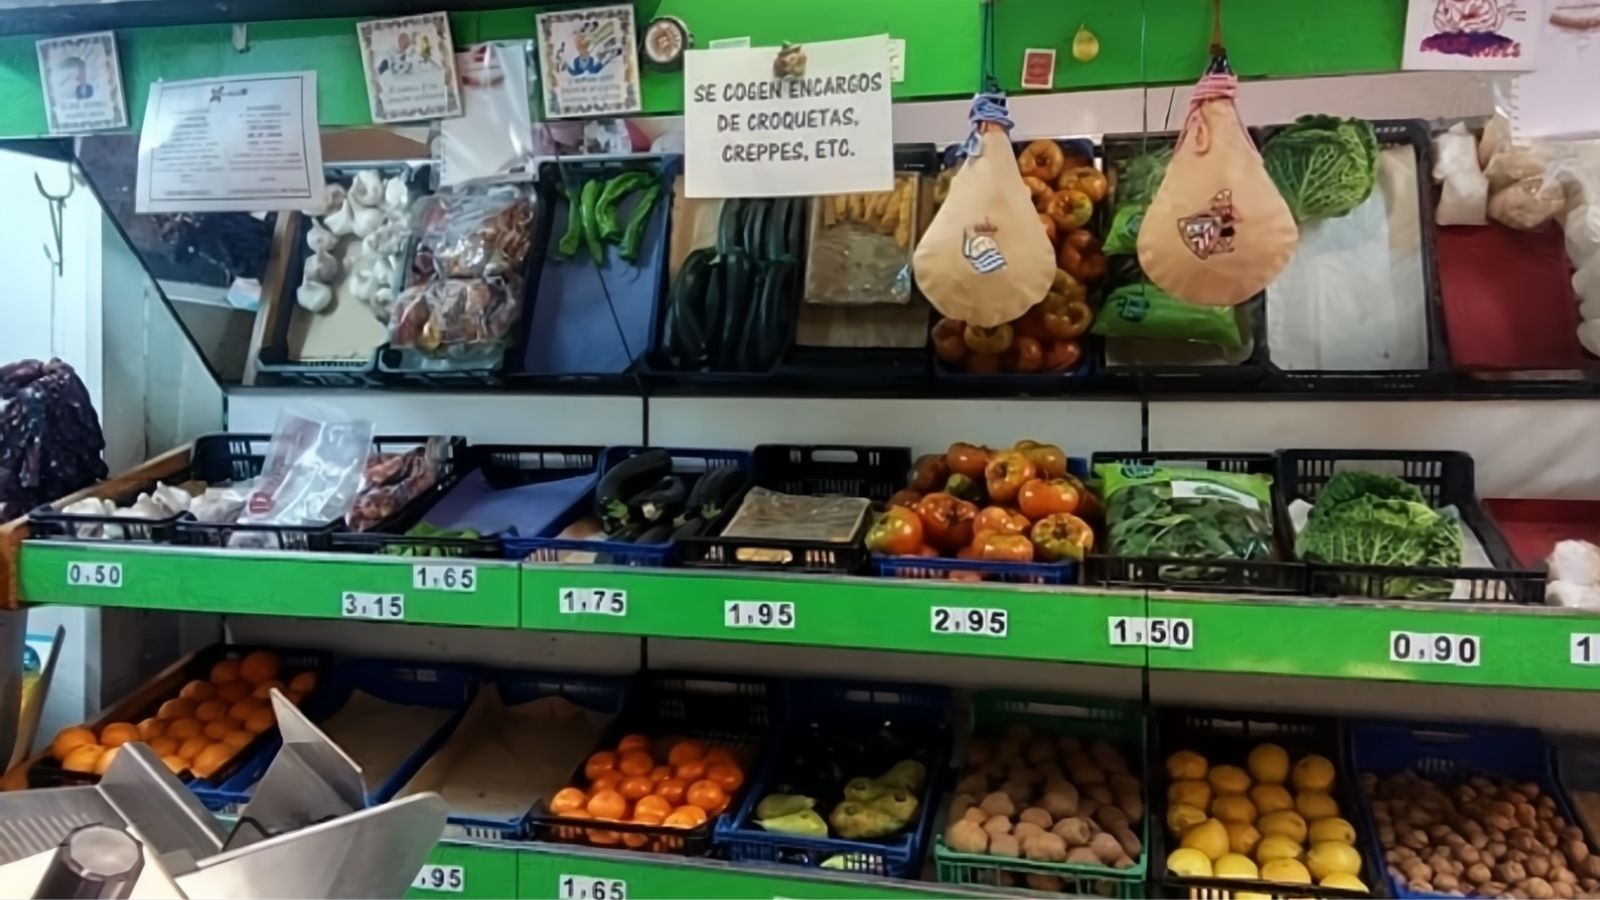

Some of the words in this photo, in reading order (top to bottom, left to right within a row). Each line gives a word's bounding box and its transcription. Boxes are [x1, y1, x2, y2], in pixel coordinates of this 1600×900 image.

[694, 84, 717, 102] SE
[722, 81, 782, 102] COGEN
[789, 72, 882, 99] ENCARGOS
[717, 114, 741, 132] DE
[747, 107, 859, 131] CROQUETAS,
[722, 142, 809, 162] CREPPES,
[815, 138, 856, 159] ETC.
[69, 564, 121, 584] 0,50
[417, 567, 473, 588] 1,65
[345, 593, 402, 616] 3,15
[563, 590, 625, 613] 1,75
[728, 603, 793, 626] 1,95
[934, 609, 1006, 634] 2,95
[1114, 619, 1190, 645] 1,50
[1393, 633, 1477, 664] 0,90
[421, 868, 462, 889] ,95
[563, 877, 624, 900] 1,65
